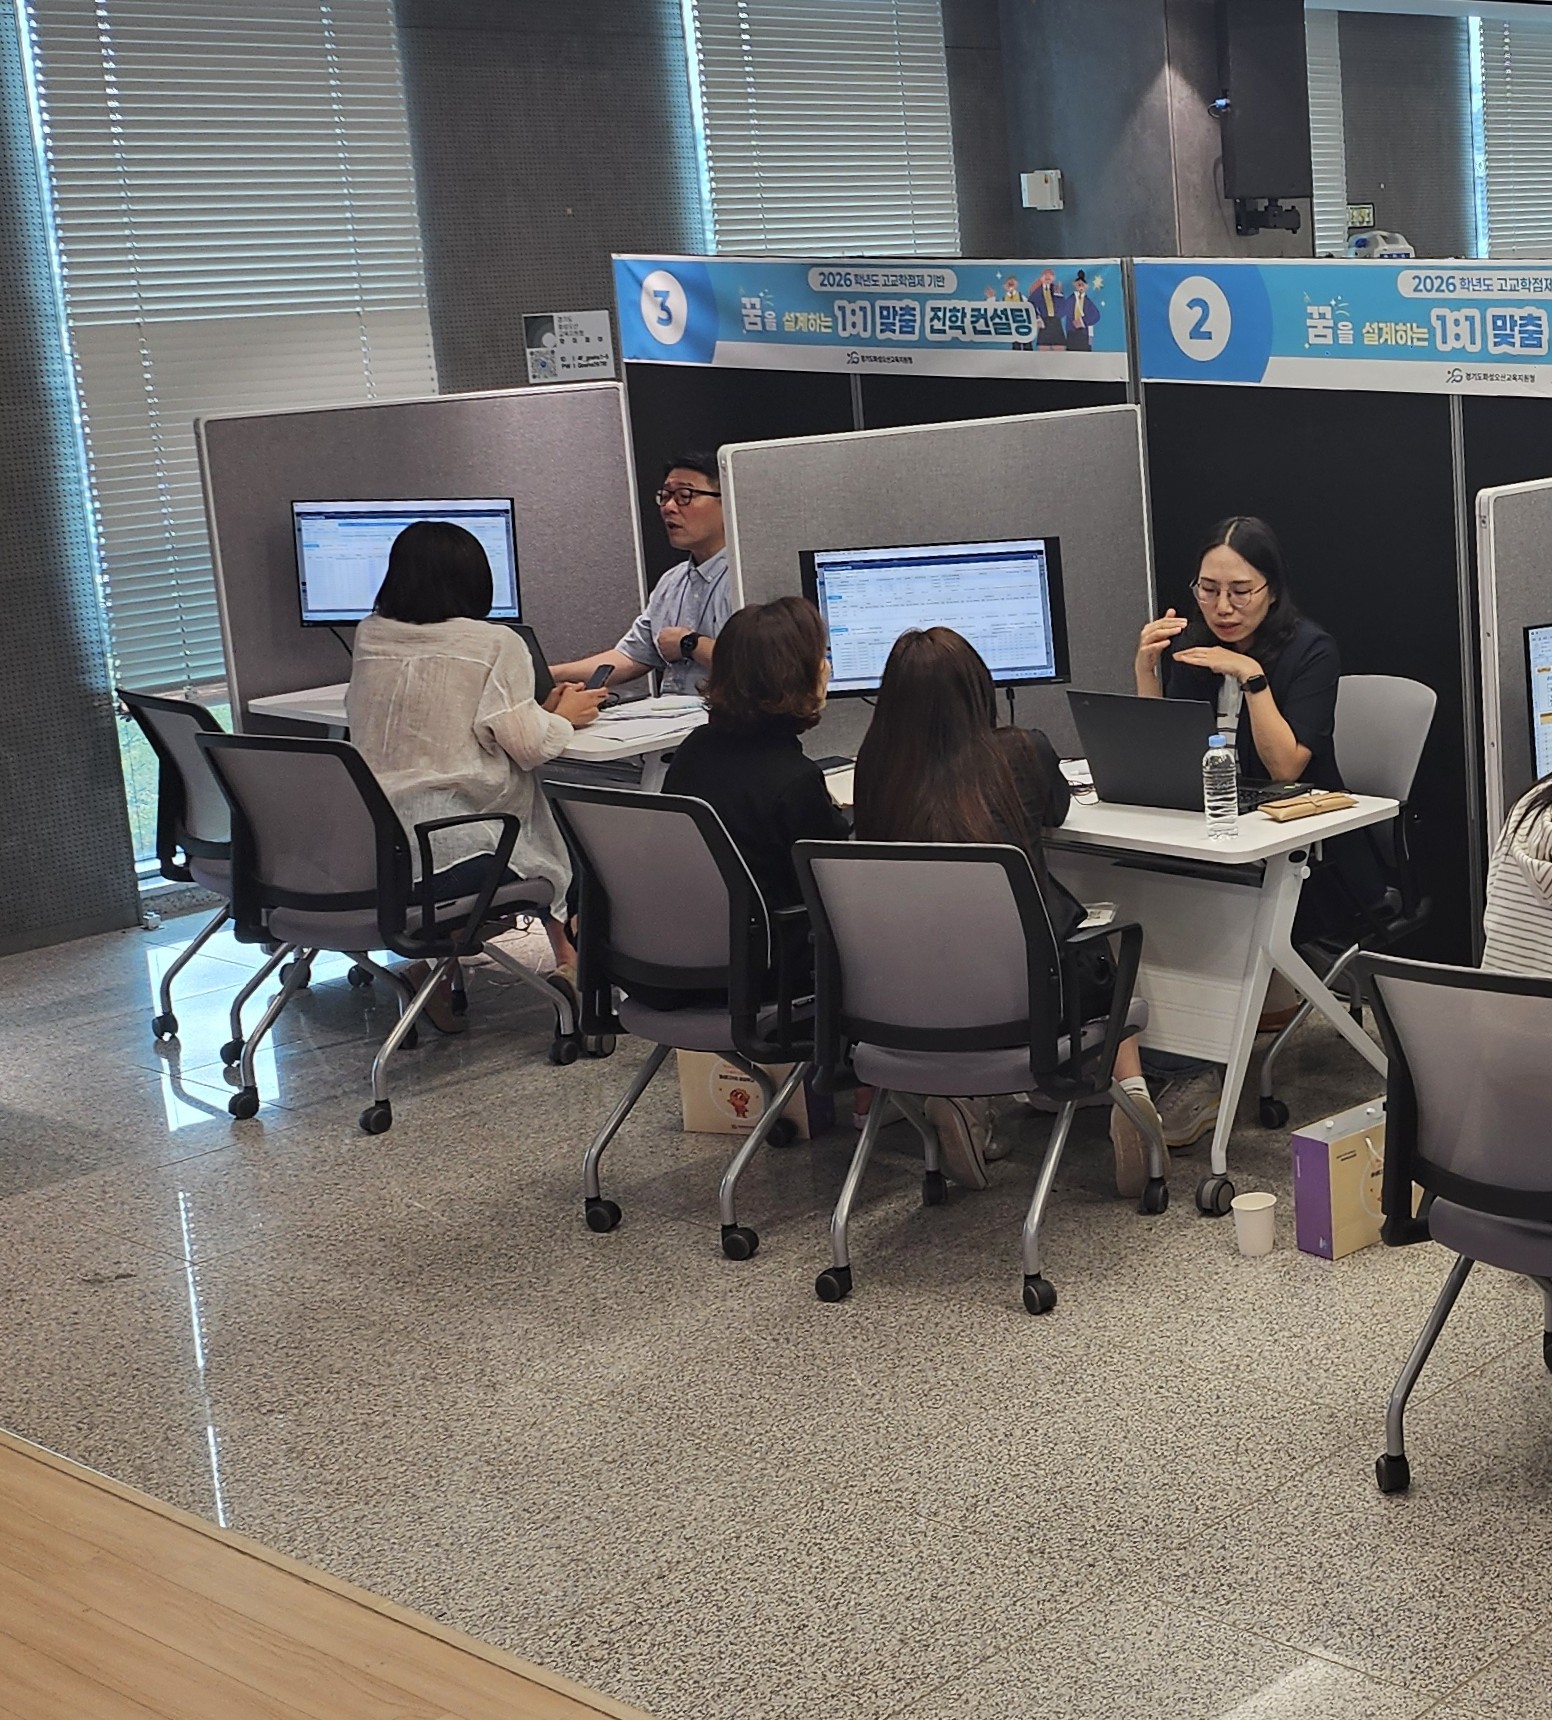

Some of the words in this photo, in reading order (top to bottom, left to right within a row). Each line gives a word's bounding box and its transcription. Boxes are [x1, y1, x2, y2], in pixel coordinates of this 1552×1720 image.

[818, 271, 852, 288] 2026
[854, 274, 880, 288] 학년도
[882, 274, 925, 288] 고교학점제
[926, 274, 945, 288] 기반
[1412, 274, 1457, 294] 2026
[1459, 277, 1494, 293] 학년도
[653, 290, 673, 327] 3
[740, 296, 777, 332] 꿈을
[782, 312, 833, 334] 설계하는
[836, 303, 869, 334] 1:1
[879, 304, 917, 336] 맞춤
[929, 305, 967, 336] 진학
[970, 306, 1033, 338] 컨설팅
[1186, 297, 1213, 341] 2
[1306, 305, 1354, 346] 꿈을
[1362, 321, 1429, 348] 설계하는
[1436, 314, 1477, 346] 1:1
[1491, 312, 1544, 349] 맞춤
[1465, 371, 1536, 384] 경기도화성오산교육지원청
